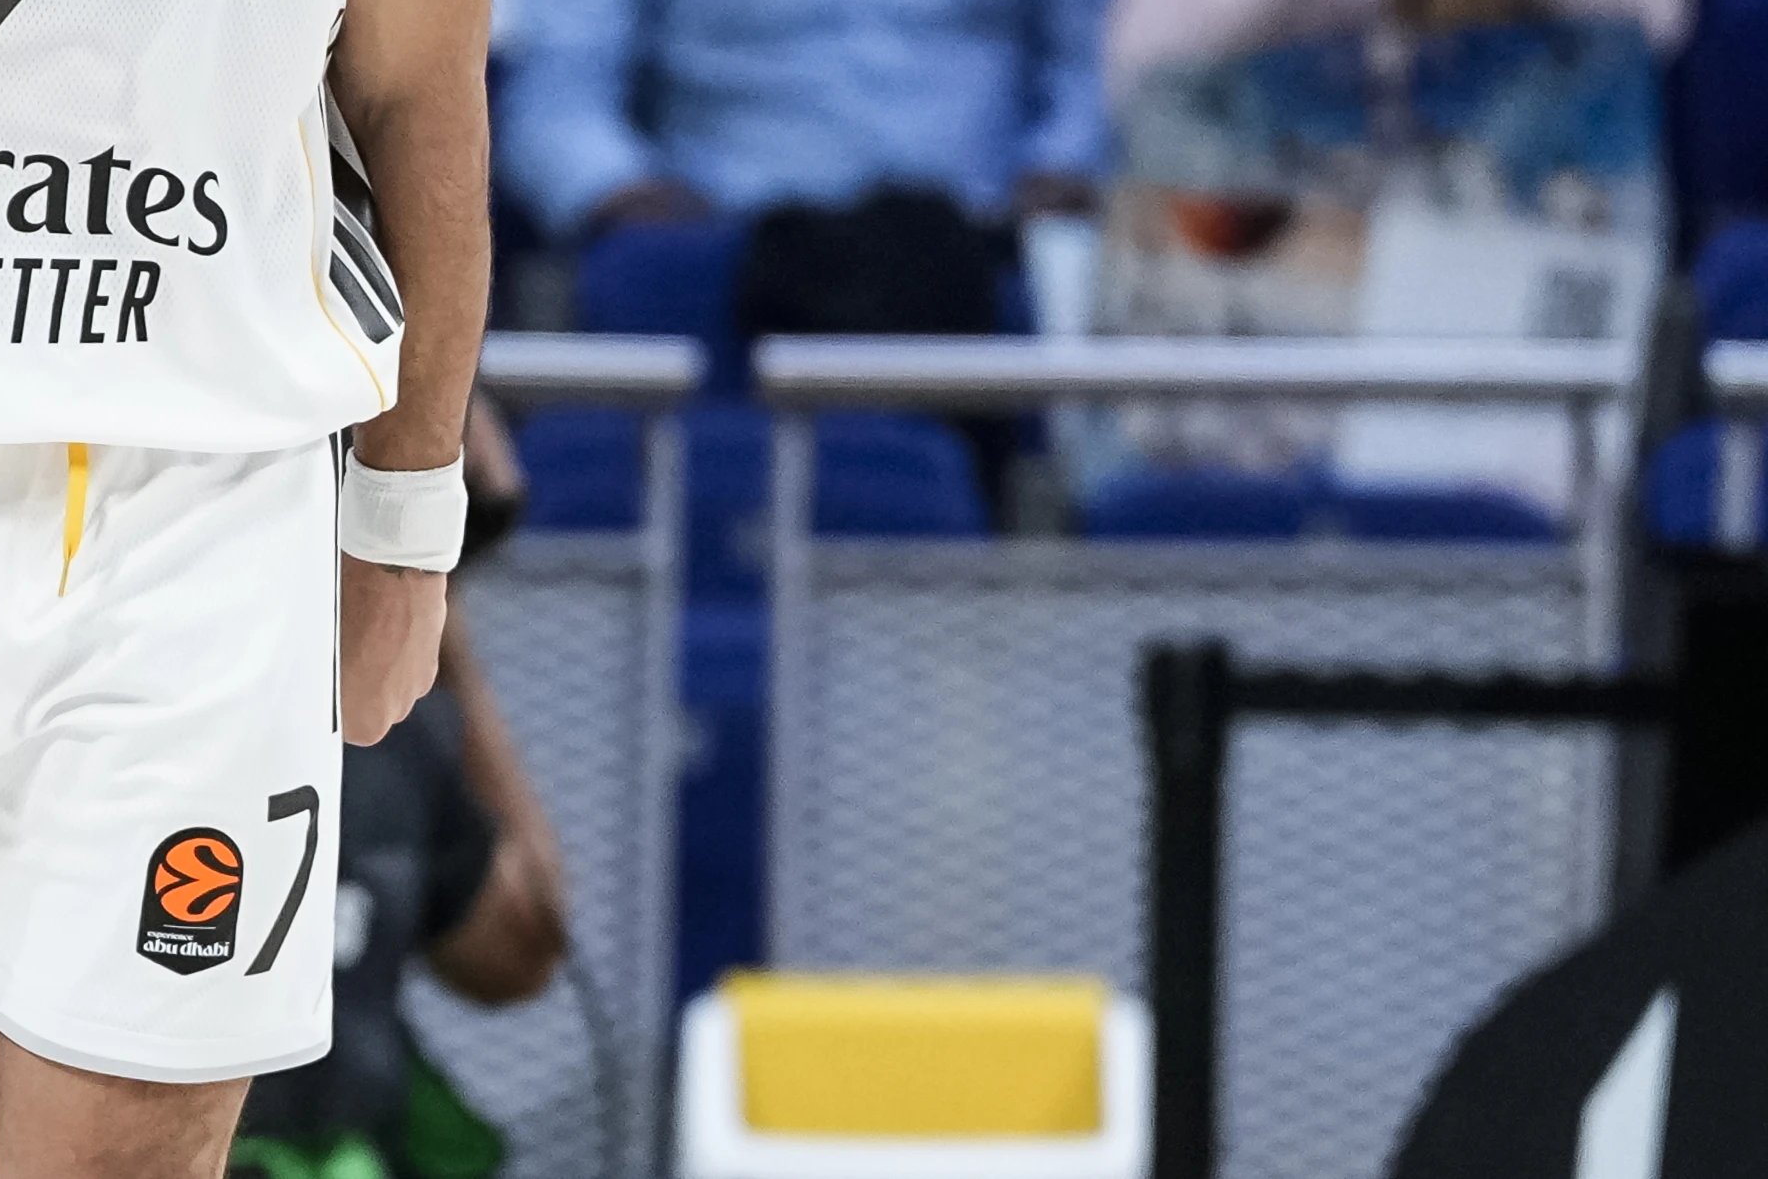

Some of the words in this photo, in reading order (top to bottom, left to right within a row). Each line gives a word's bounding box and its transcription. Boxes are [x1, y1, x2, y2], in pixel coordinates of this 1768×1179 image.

[243, 785, 319, 976] 7
[142, 939, 178, 955] abu
[179, 941, 230, 957] dhabi
